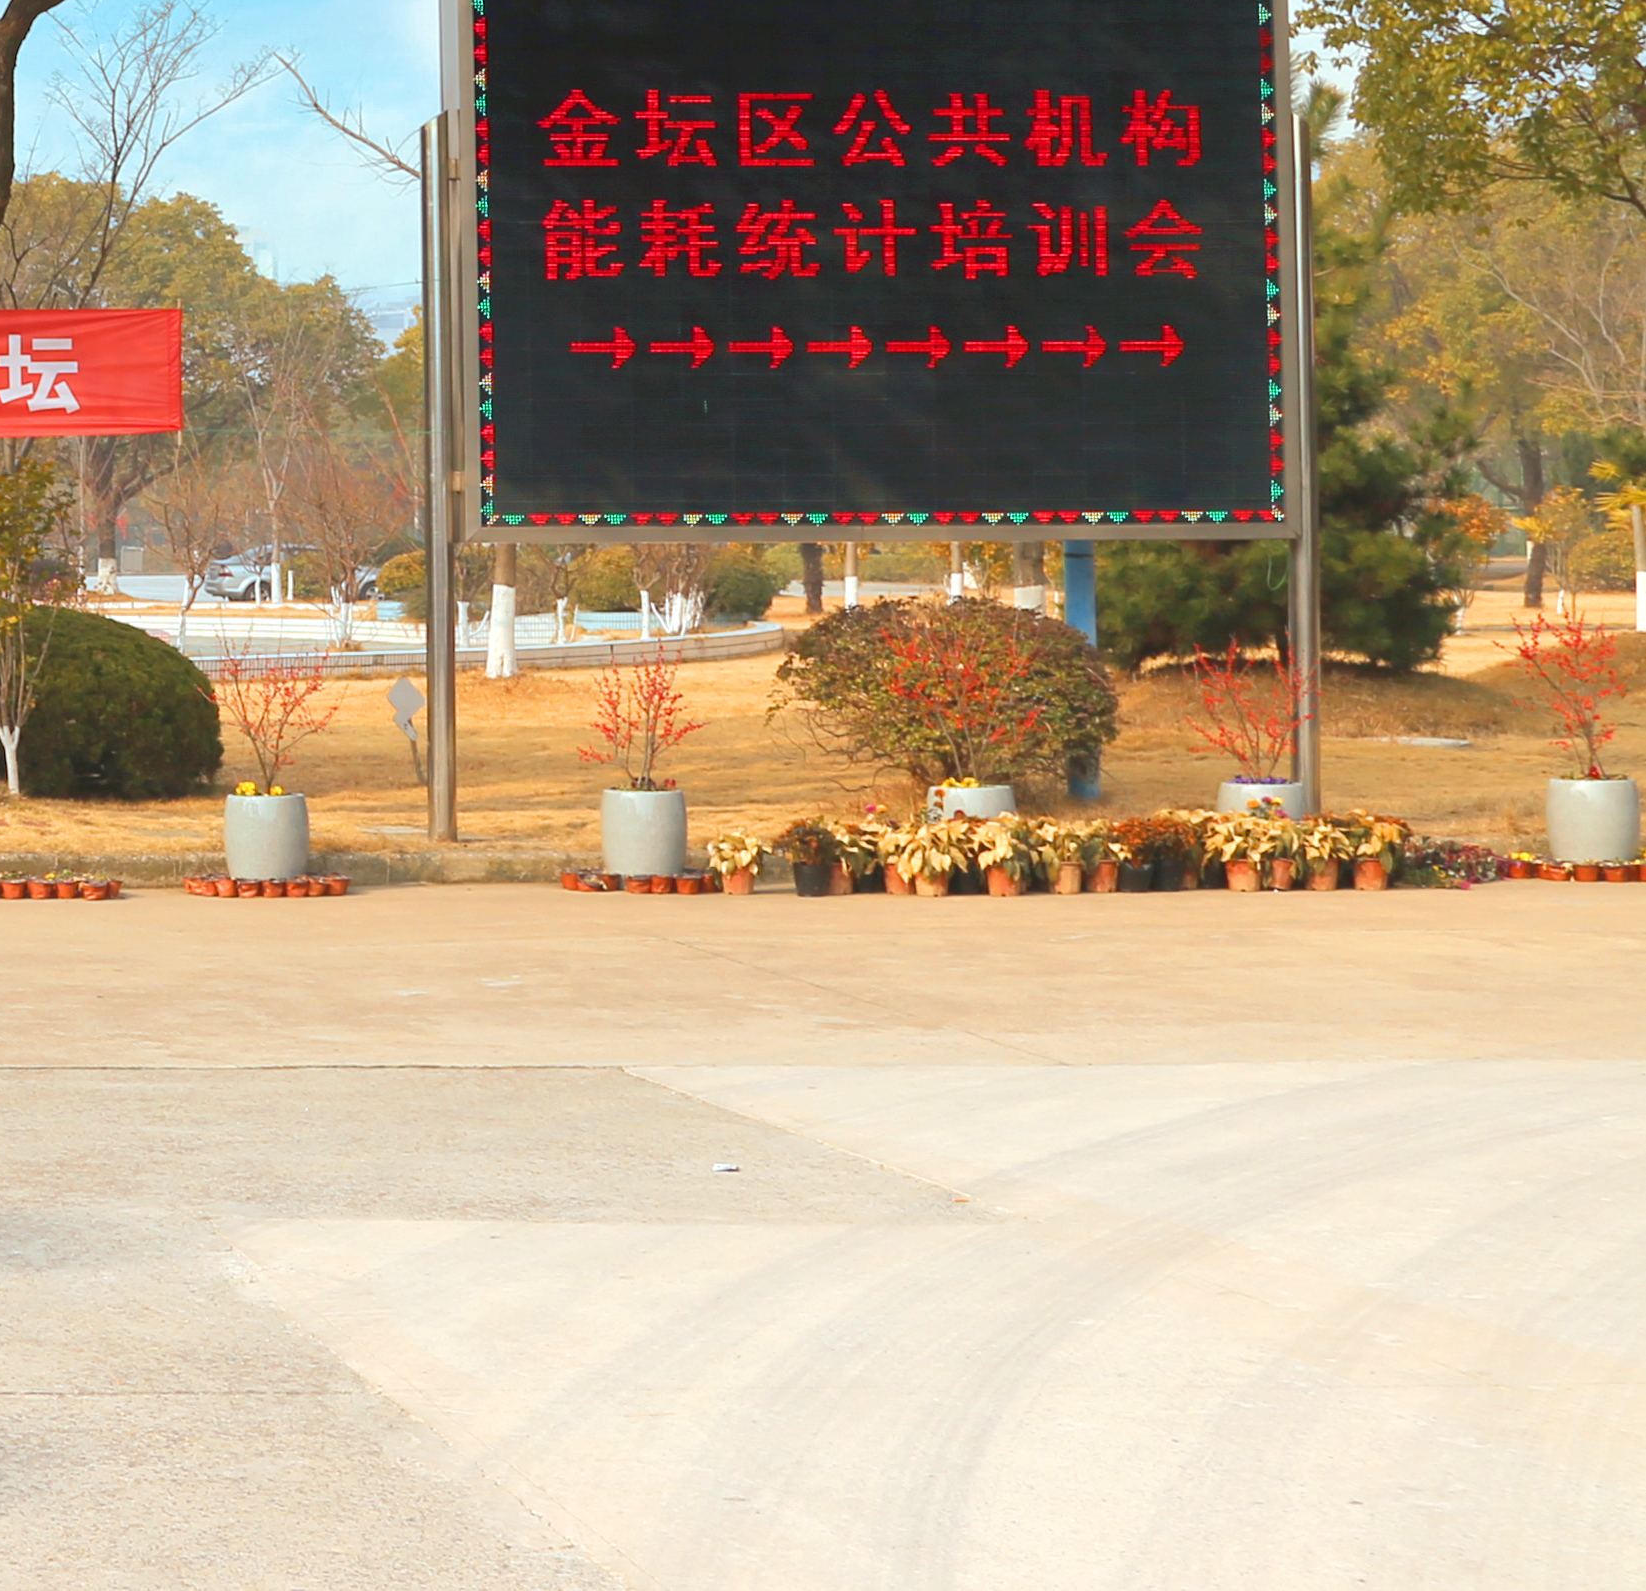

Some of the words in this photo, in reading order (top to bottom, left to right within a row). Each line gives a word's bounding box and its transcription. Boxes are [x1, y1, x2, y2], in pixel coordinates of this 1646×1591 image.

[537, 89, 1201, 166] 金坛区公共机构
[542, 199, 1202, 280] 能耗统计培训会
